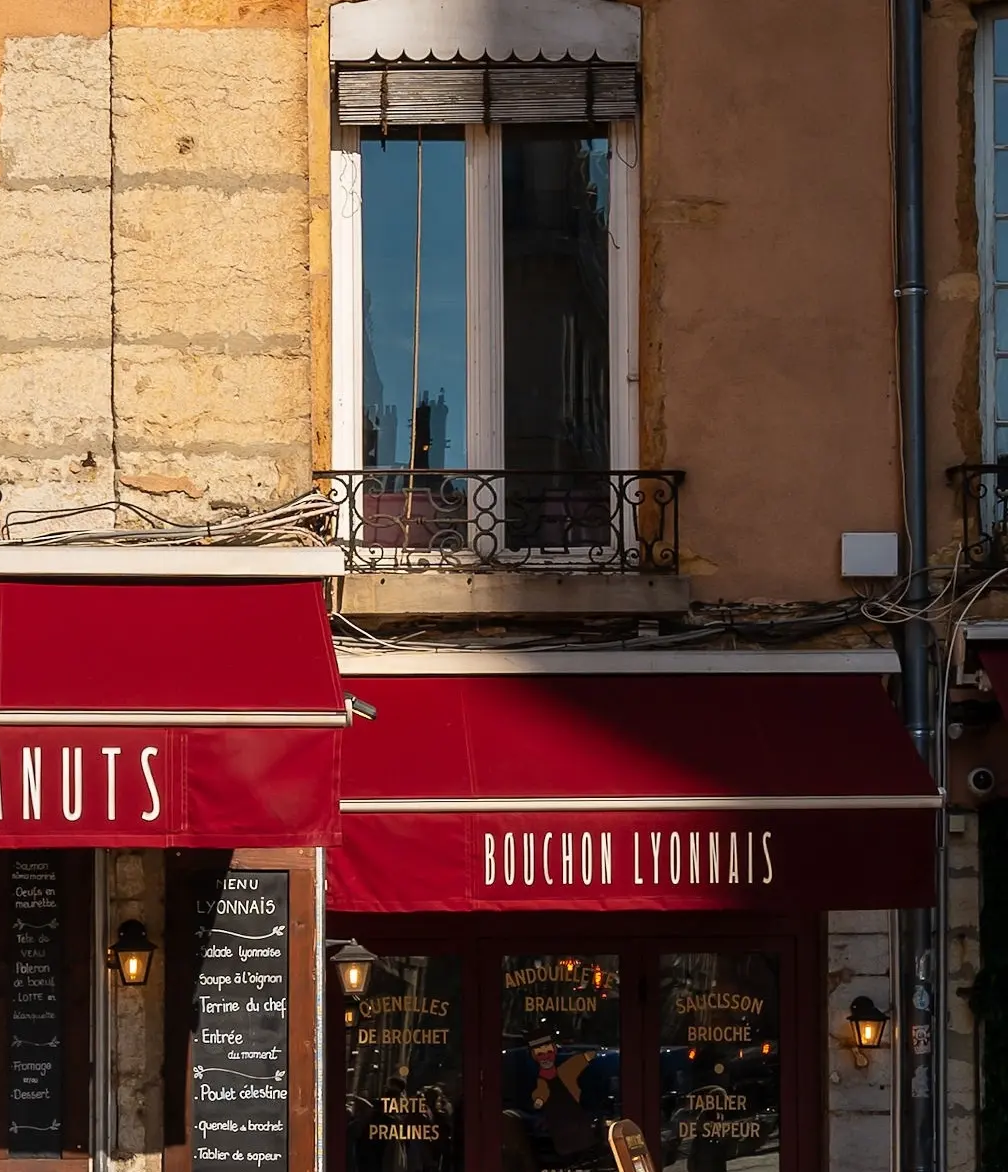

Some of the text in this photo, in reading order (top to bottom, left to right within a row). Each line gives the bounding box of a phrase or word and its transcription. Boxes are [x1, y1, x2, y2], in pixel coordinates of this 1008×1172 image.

[483, 831, 774, 886] BOUCHON LYONNAIS
[215, 878, 259, 891] MENU
[200, 944, 282, 962] Salade lyonnaise
[198, 973, 232, 991] Soupe
[198, 996, 287, 1018] Terrine du chef
[358, 995, 450, 1018] QUENELLES
[524, 996, 597, 1013] BRAILLON
[675, 993, 764, 1015] SAUCISSON
[201, 1028, 244, 1045] Entrée
[358, 1028, 450, 1045] DE BROCHET
[227, 1046, 283, 1061] du moment
[12, 1060, 52, 1077] Fromage
[13, 1088, 51, 1100] Dessert
[200, 1084, 288, 1101] Poulet célestine
[380, 1097, 427, 1113] TARTE
[688, 1094, 747, 1111] TABLIER
[247, 1120, 284, 1132] brochet
[368, 1123, 441, 1141] PRALINES
[679, 1121, 761, 1138] DE SAPEUR
[197, 1147, 282, 1168] Tablier de sapeur
